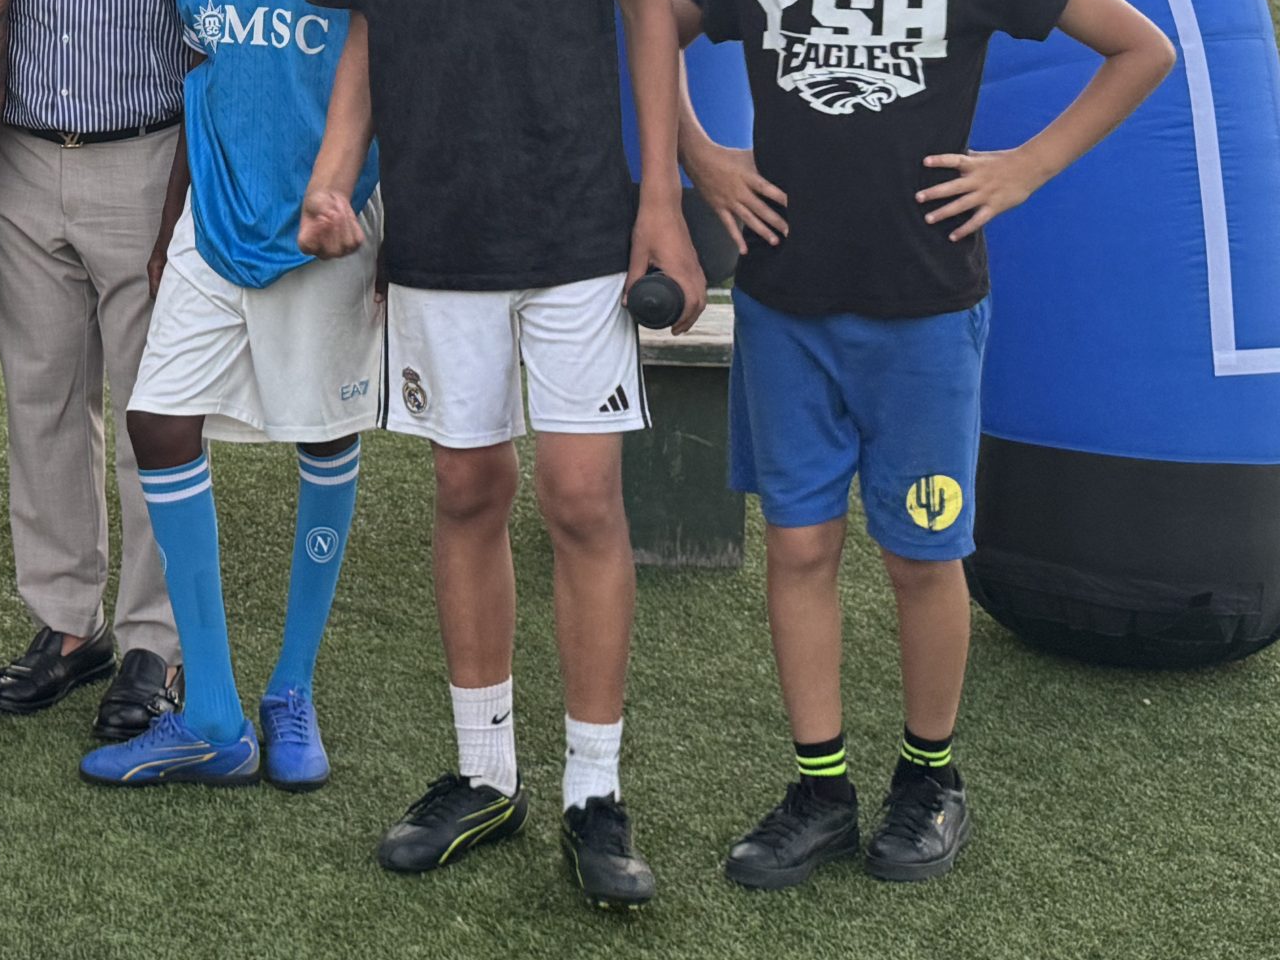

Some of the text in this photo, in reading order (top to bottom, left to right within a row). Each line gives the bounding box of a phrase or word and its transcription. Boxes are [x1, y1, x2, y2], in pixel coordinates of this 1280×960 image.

[220, 5, 329, 55] MSC
[782, 40, 925, 85] EAGLES
[341, 380, 369, 400] EA7
